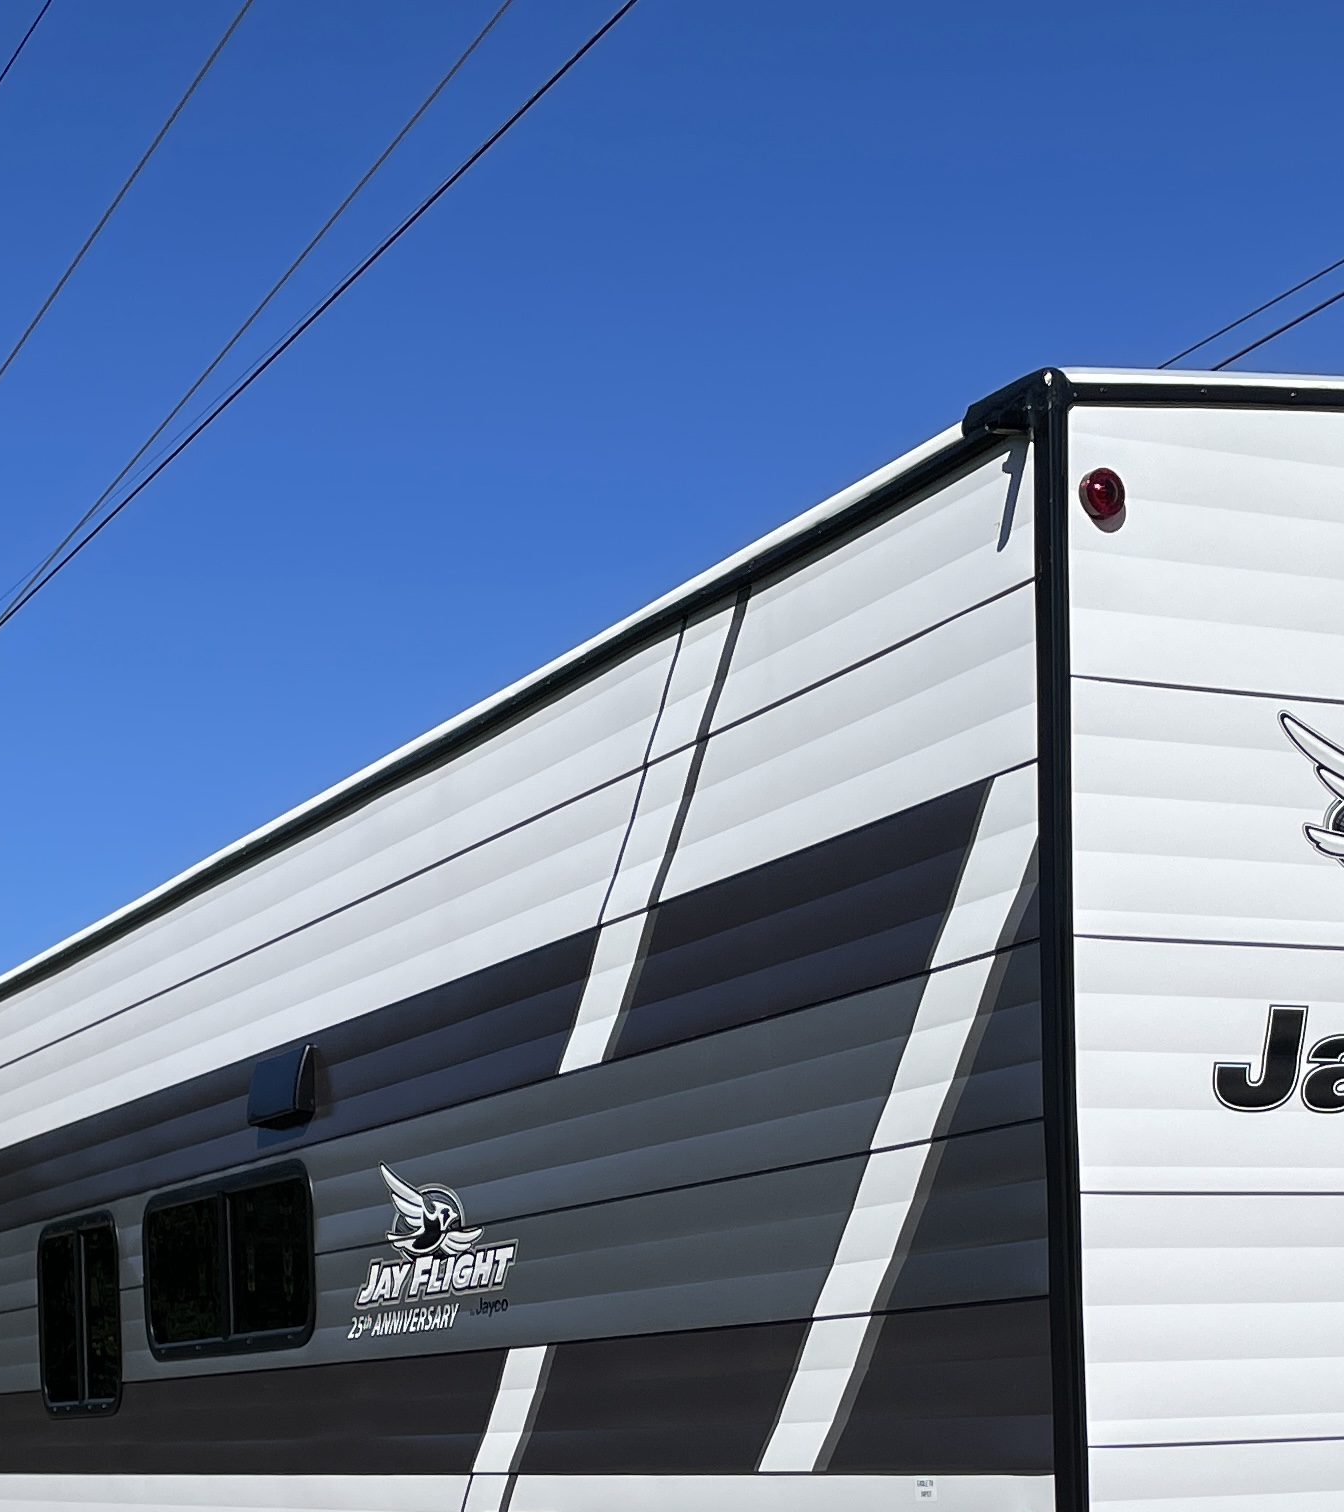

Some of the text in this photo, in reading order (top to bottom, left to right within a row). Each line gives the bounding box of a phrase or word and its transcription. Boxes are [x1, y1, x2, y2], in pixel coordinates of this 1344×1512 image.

[357, 1245, 516, 1305] JAY FLIGHT
[347, 1303, 460, 1340] 25th ANNIVERSARY
[475, 1297, 509, 1318] Jayco
